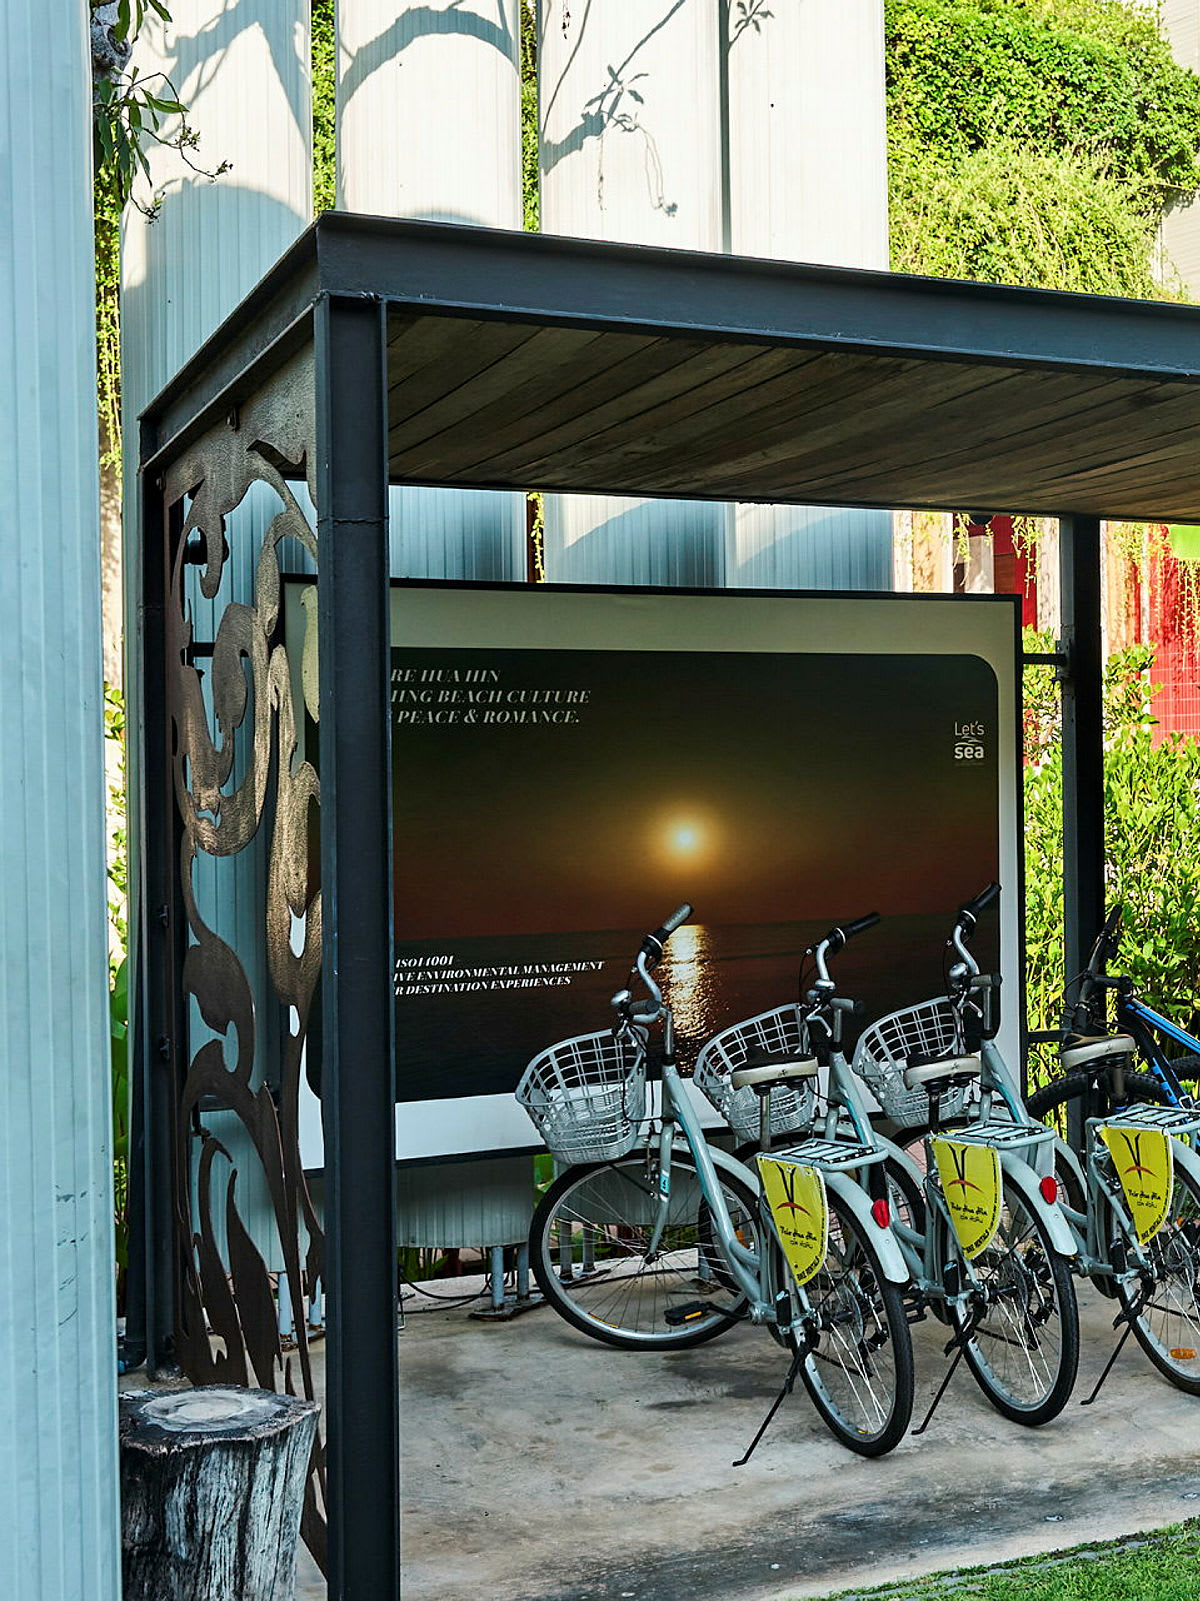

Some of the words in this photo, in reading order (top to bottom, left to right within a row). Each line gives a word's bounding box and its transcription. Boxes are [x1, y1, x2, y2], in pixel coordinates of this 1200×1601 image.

[421, 669, 460, 682] HUA
[465, 669, 501, 682] HIN
[438, 690, 503, 703] BEACH
[506, 690, 592, 703] CULTURE
[398, 710, 461, 723] PEACE
[464, 708, 480, 723] &
[483, 710, 580, 723] ROMANCE.
[954, 720, 985, 736] Let's
[954, 746, 984, 759] sea
[417, 965, 520, 981] ENVIRONMENTAL
[522, 961, 606, 975] MANAGEMENT
[405, 981, 489, 995] DESTINATION
[490, 976, 572, 990] EXPERIENCES
